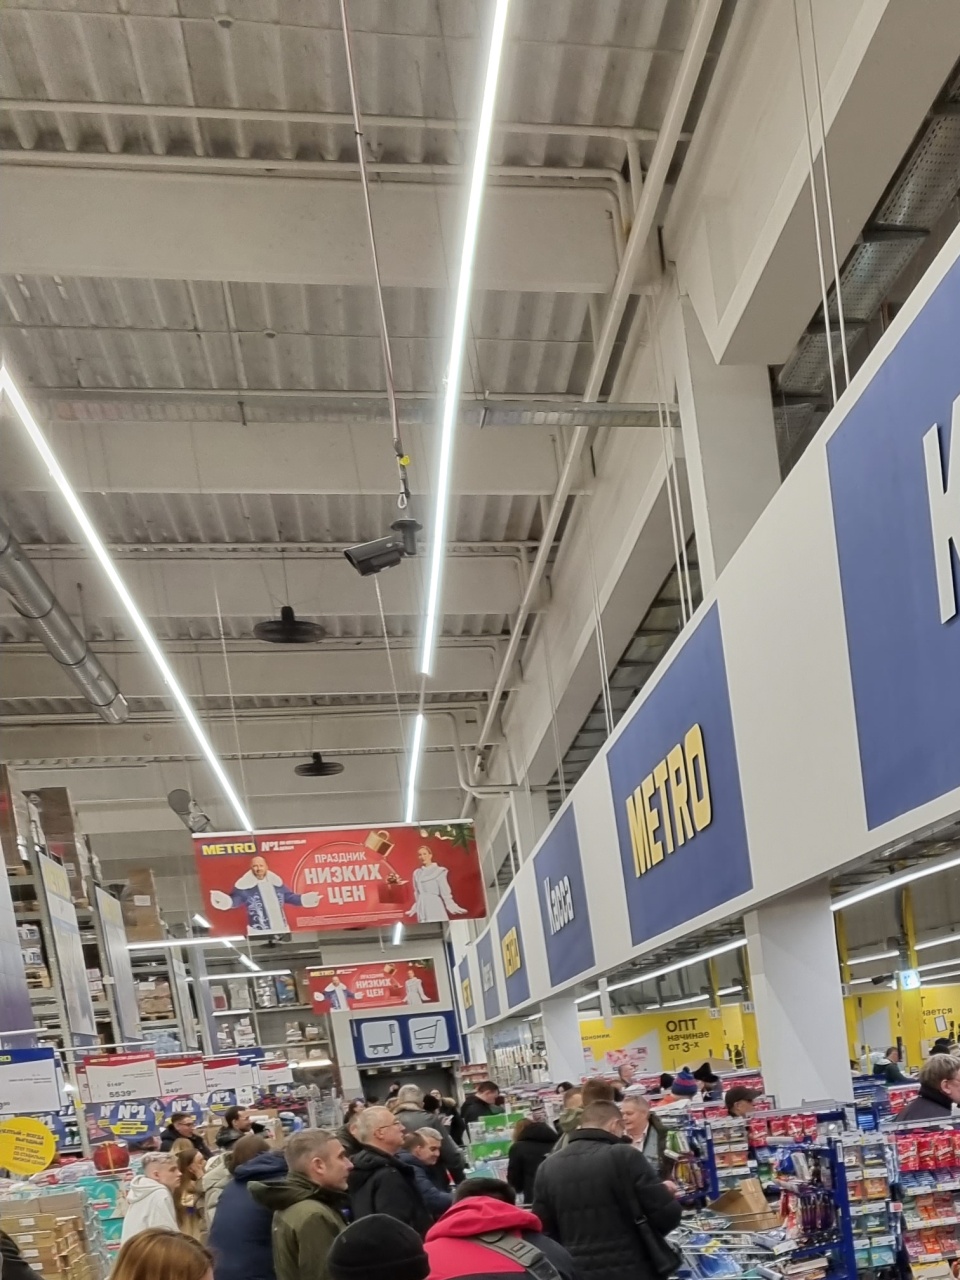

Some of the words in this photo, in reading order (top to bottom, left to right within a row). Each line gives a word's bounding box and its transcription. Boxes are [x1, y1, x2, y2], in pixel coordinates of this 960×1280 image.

[626, 723, 712, 878] METRO
[202, 843, 256, 856] METRO
[314, 851, 367, 864] ПРАЗДНИК
[304, 864, 382, 885] НИЗКИХ
[543, 875, 575, 936] Касса
[665, 1018, 698, 1033] ОПТ
